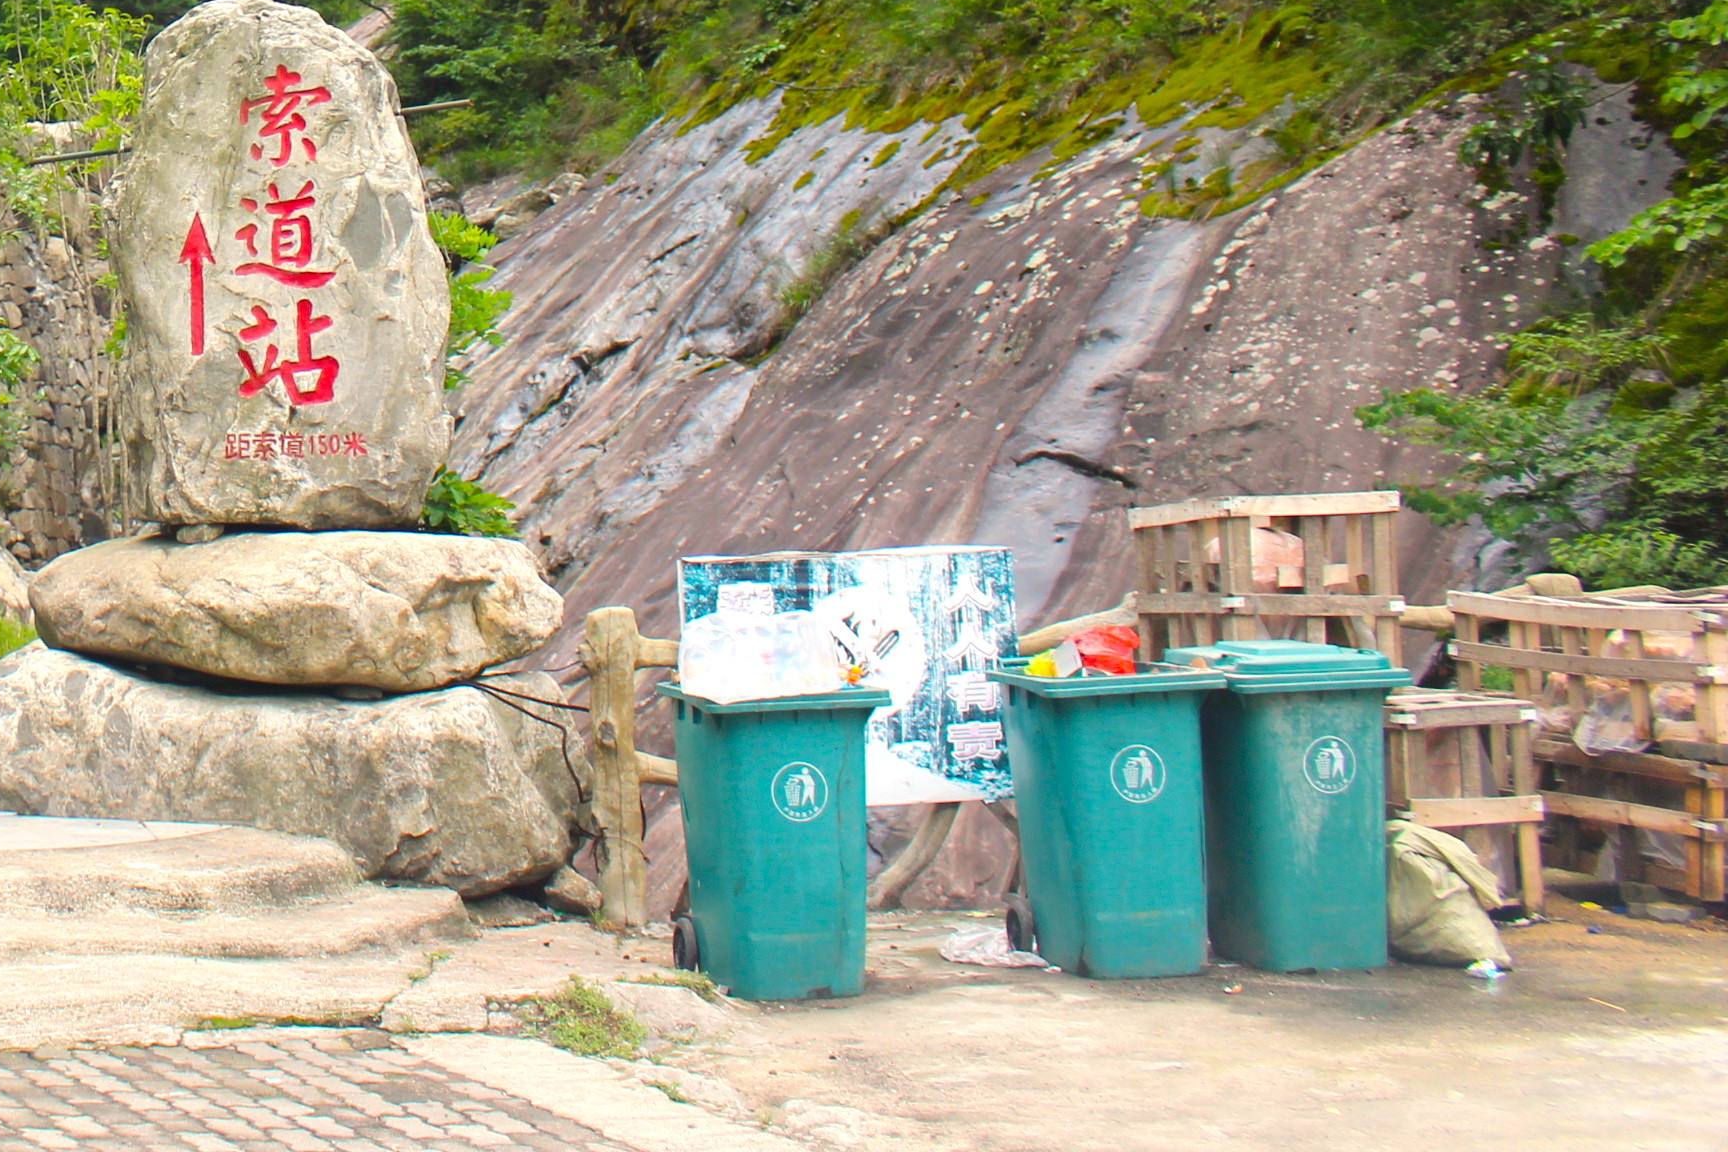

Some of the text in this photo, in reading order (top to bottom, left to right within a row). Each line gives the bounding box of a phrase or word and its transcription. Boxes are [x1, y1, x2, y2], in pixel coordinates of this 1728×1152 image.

[234, 64, 340, 407] 索道站
[224, 431, 368, 461] 距索道150米
